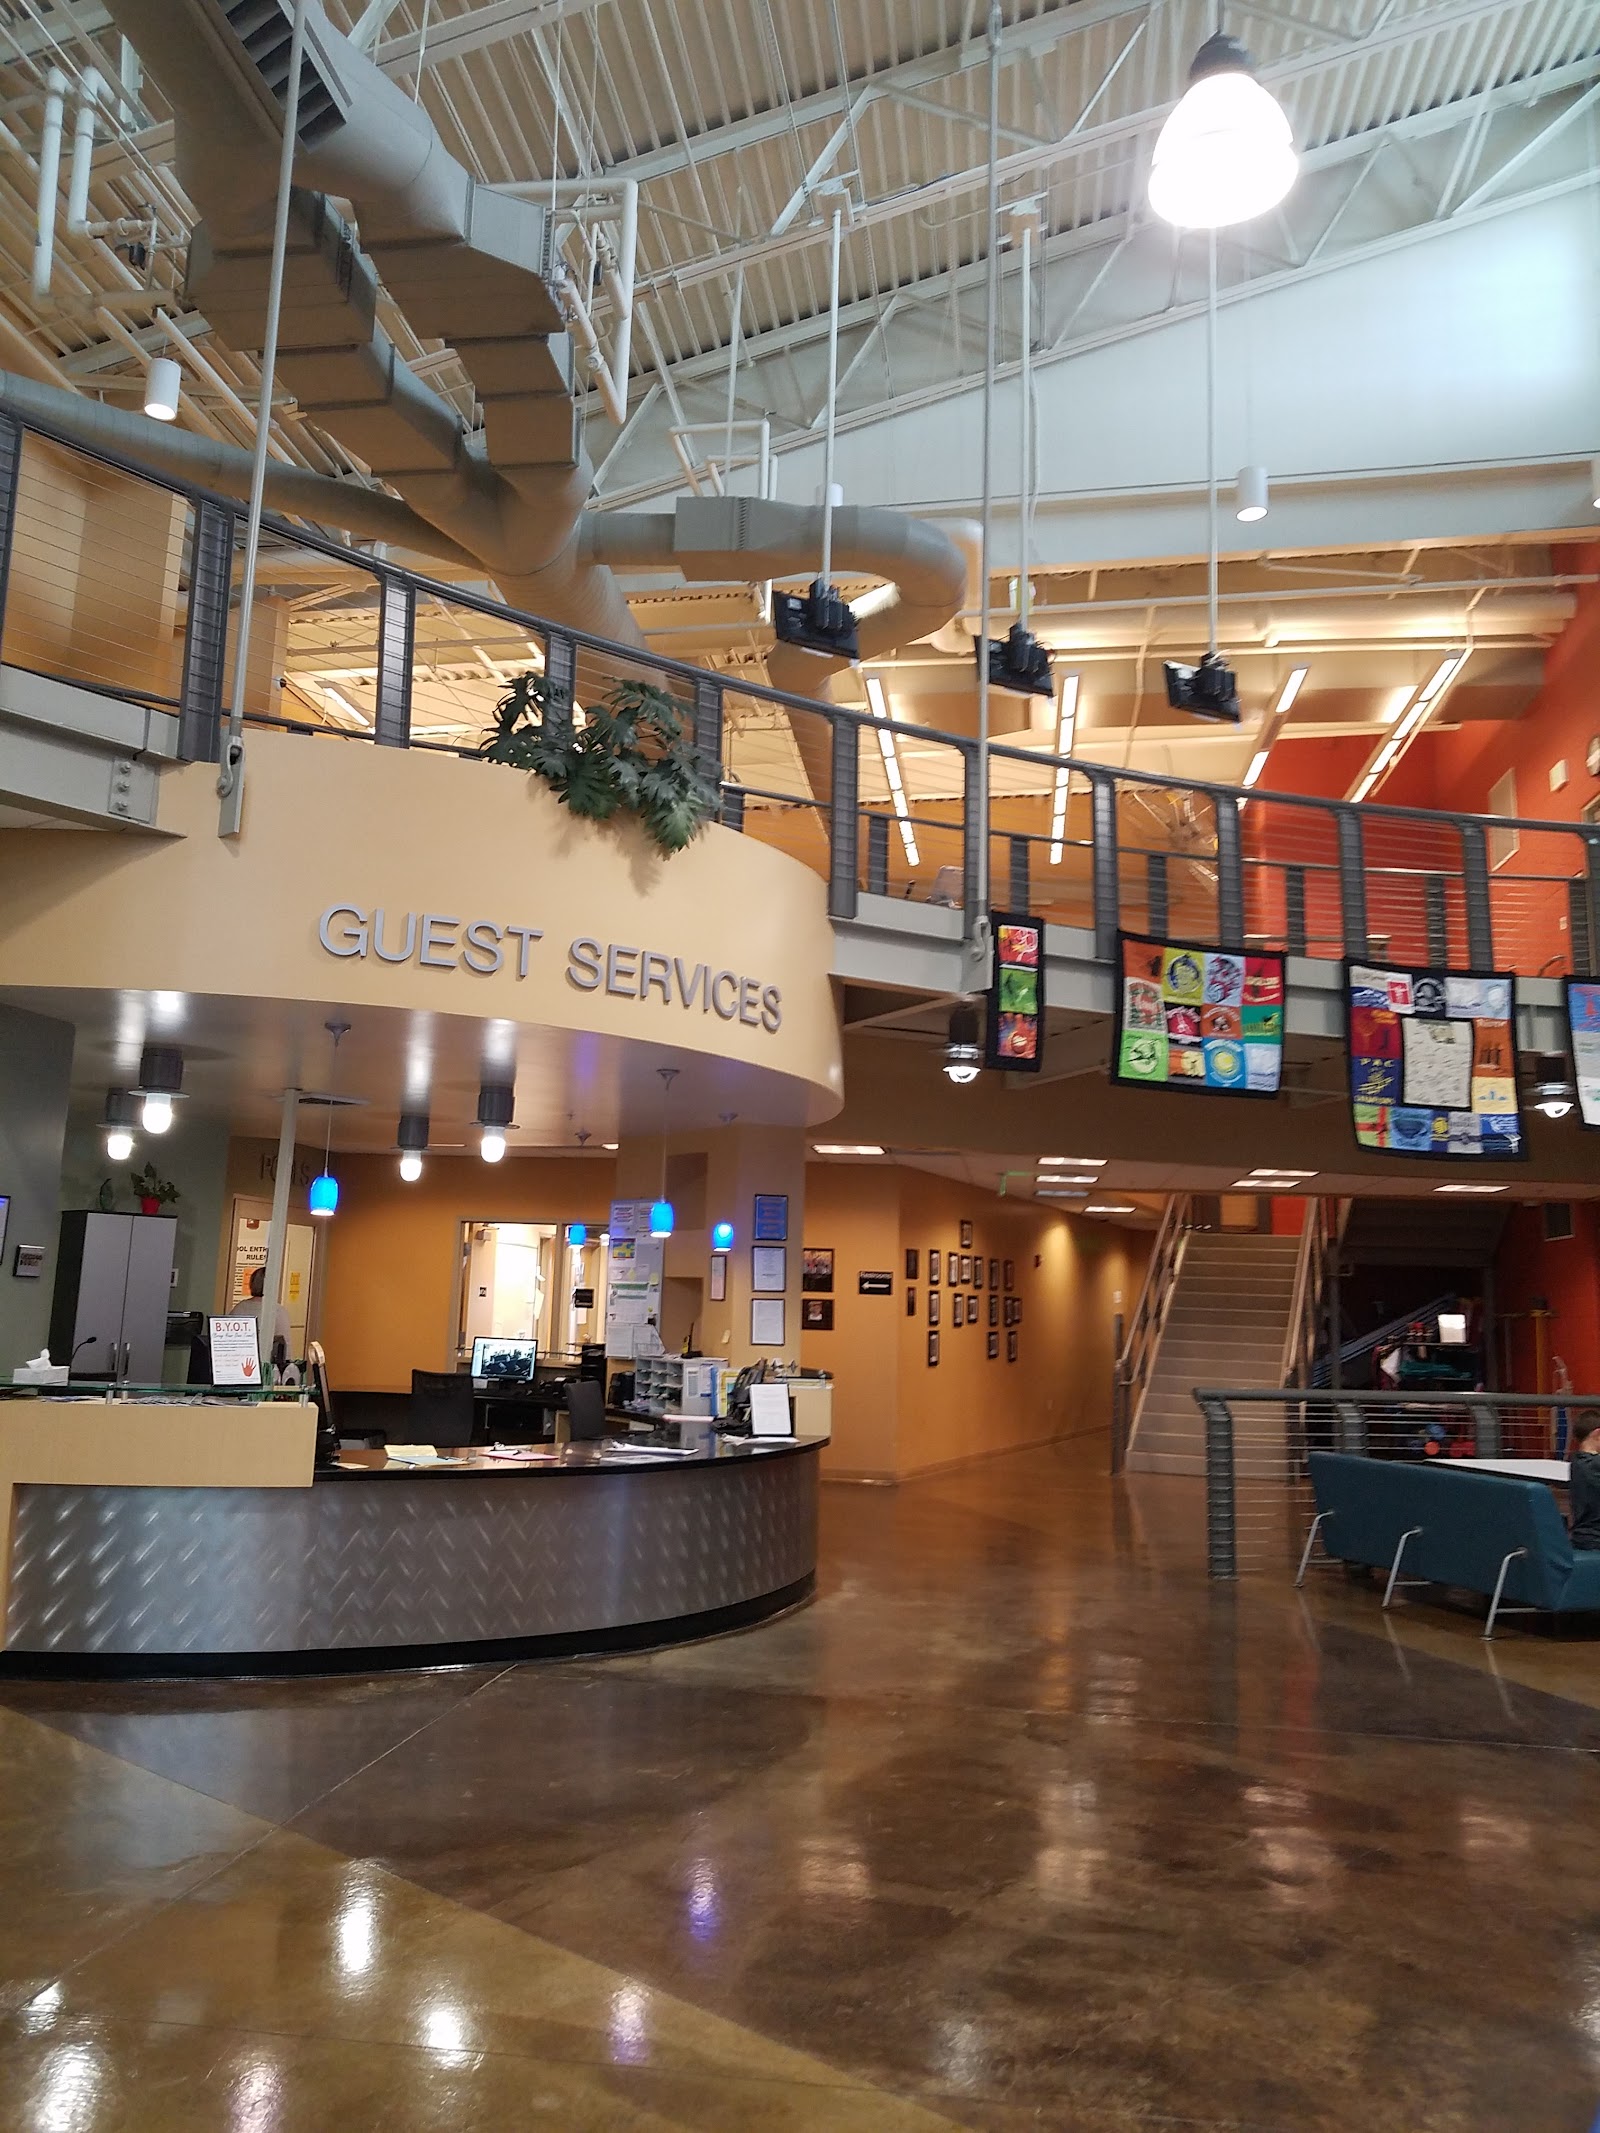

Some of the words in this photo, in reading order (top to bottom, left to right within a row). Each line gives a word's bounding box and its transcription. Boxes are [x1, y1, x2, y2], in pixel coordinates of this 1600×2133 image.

[318, 903, 544, 978] GUEST
[566, 937, 783, 1032] SERVICES
[215, 1321, 251, 1332] B.Y.O.T.
